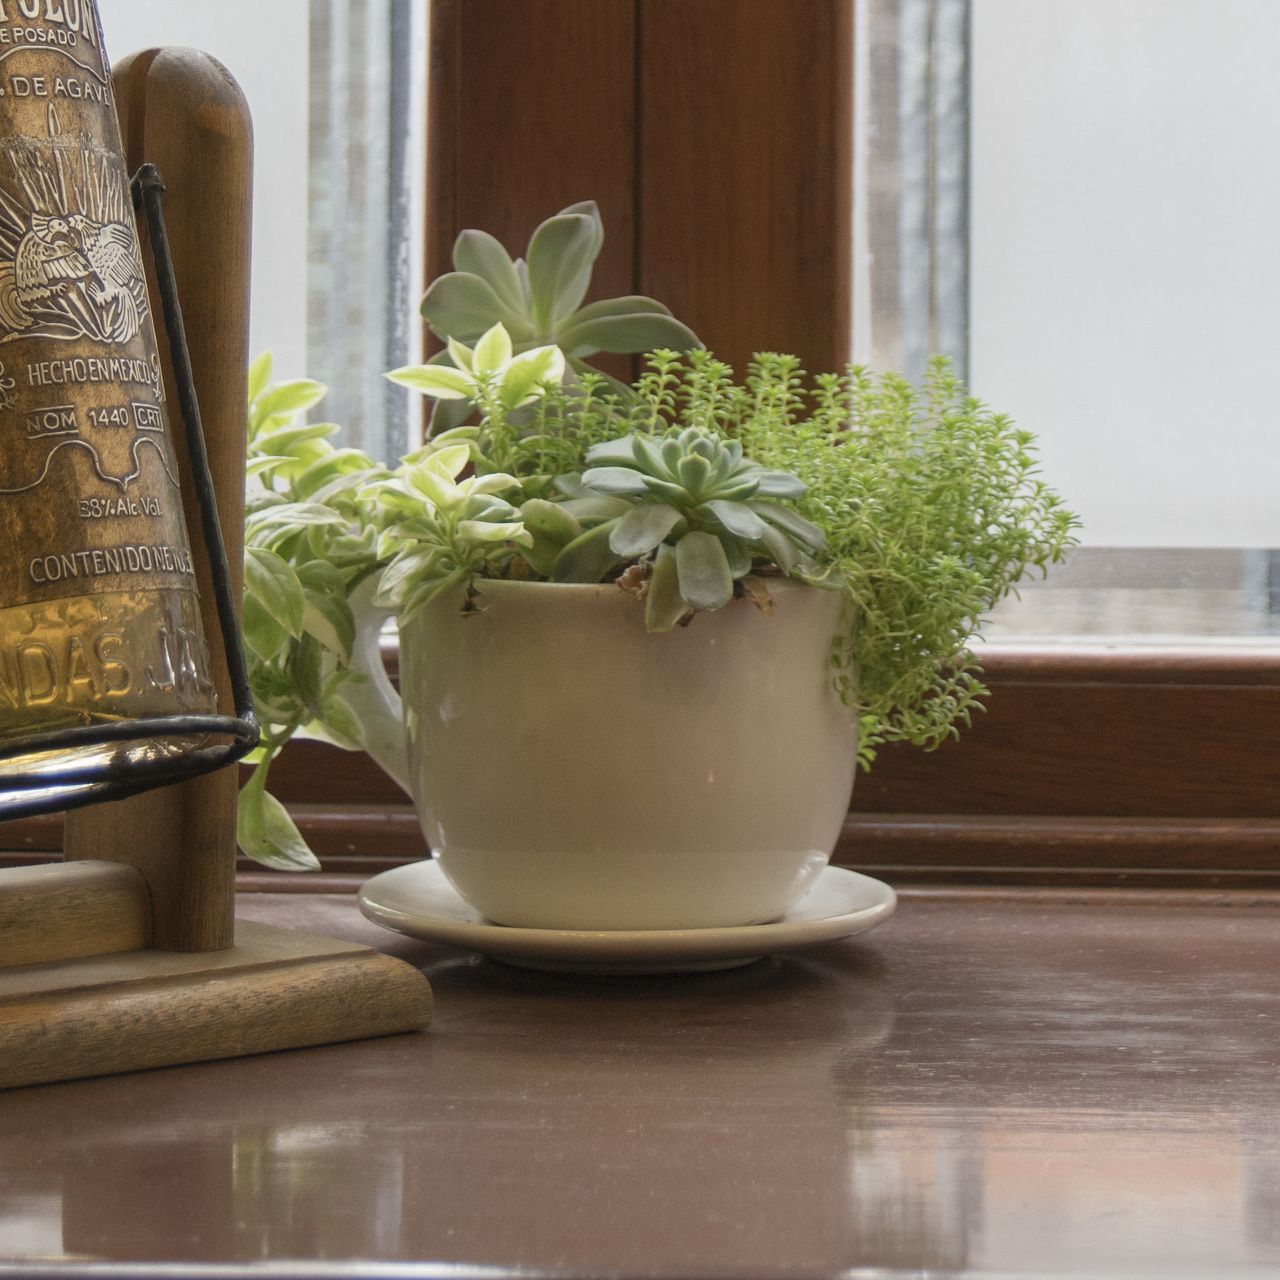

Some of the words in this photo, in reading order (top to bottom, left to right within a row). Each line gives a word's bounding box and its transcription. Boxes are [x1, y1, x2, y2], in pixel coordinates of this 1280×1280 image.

[12, 76, 49, 99] DE
[28, 359, 87, 387] HECHO
[88, 358, 111, 382] EN
[109, 358, 152, 386] MEXICO
[25, 411, 78, 434] NOM
[88, 407, 129, 428] 1440
[136, 408, 162, 426] CRT
[29, 546, 152, 584] CONTENIDO
